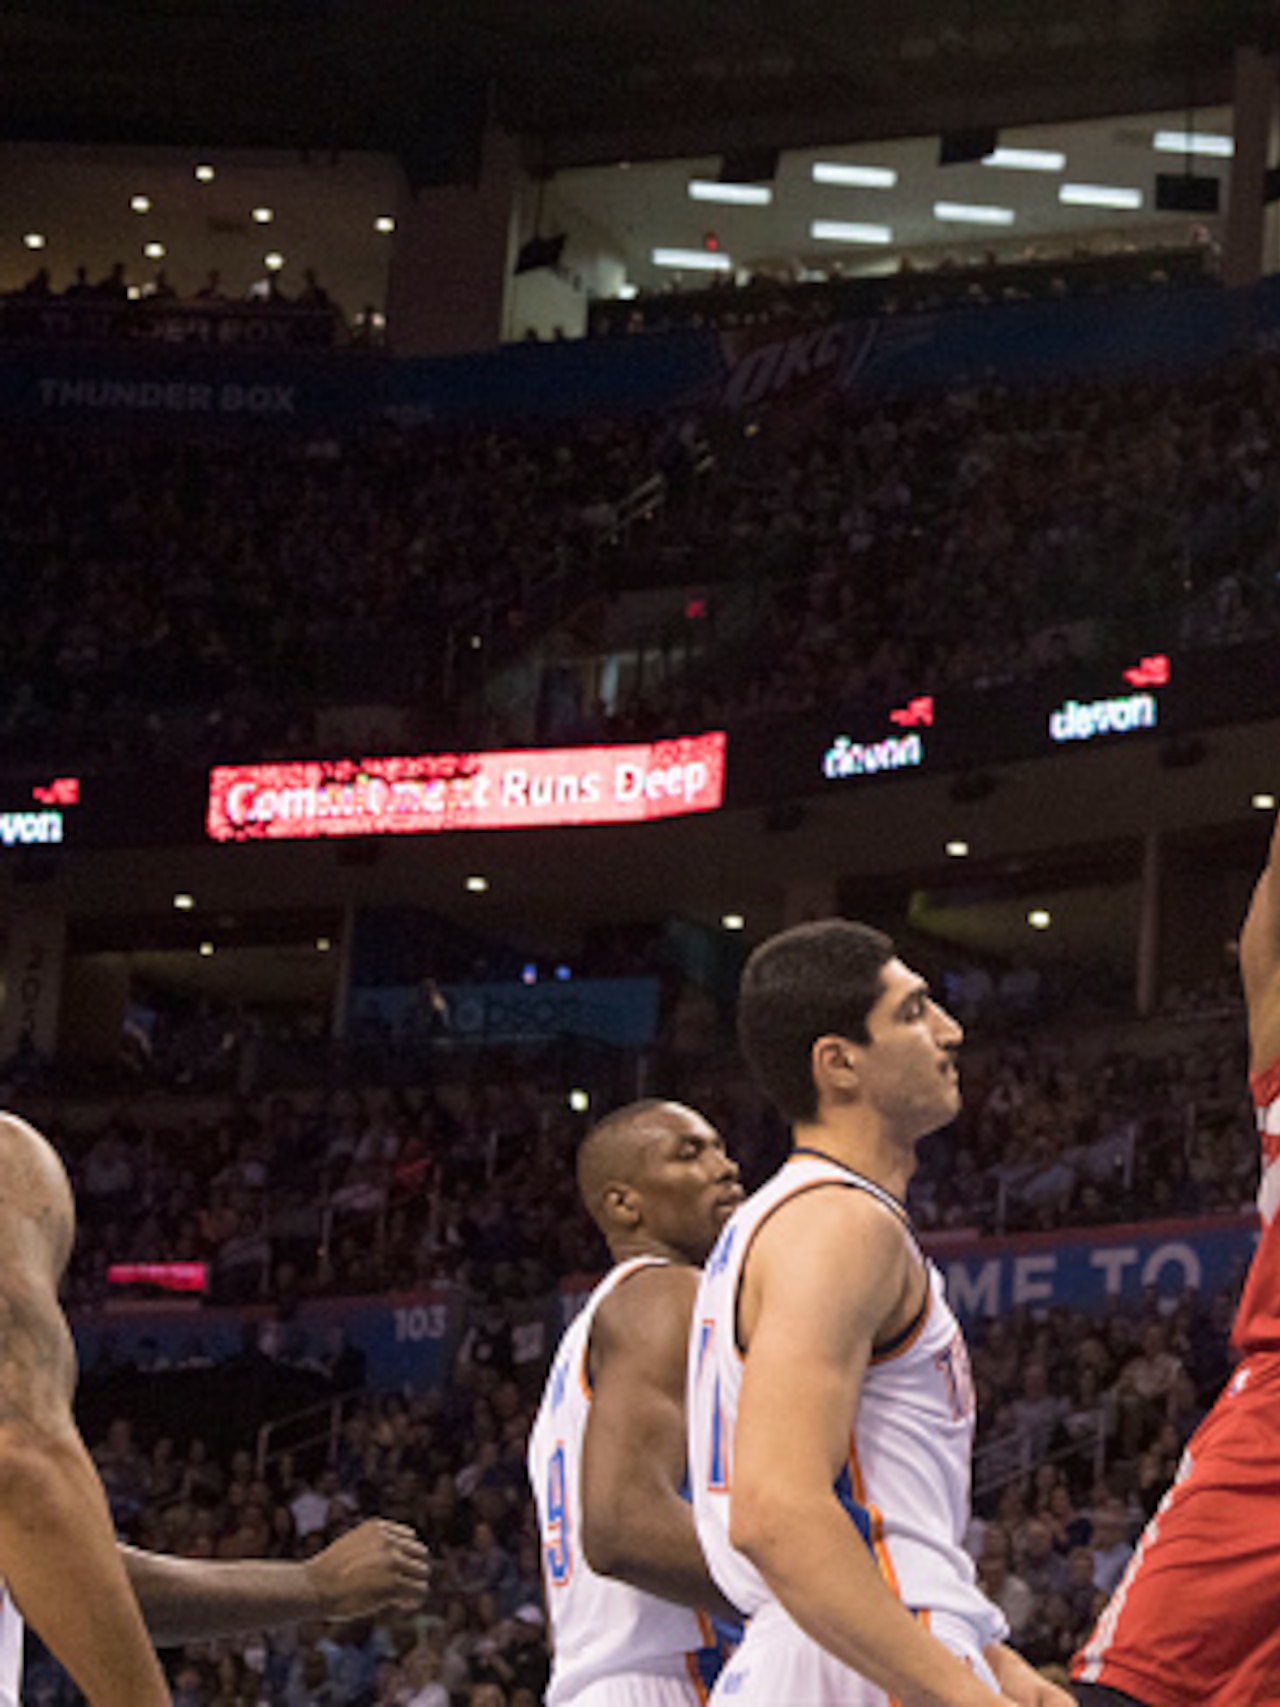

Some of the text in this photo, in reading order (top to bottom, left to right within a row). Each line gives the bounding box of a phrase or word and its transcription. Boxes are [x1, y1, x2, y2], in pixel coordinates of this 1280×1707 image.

[37, 377, 296, 412] THUNDER BOX
[1049, 693, 1157, 741] devon
[823, 733, 923, 778] devon
[501, 769, 600, 809] Runs
[614, 759, 707, 802] Deep
[1089, 1241, 1203, 1296] TO
[392, 1303, 449, 1343] 103
[543, 1438, 575, 1588] 9
